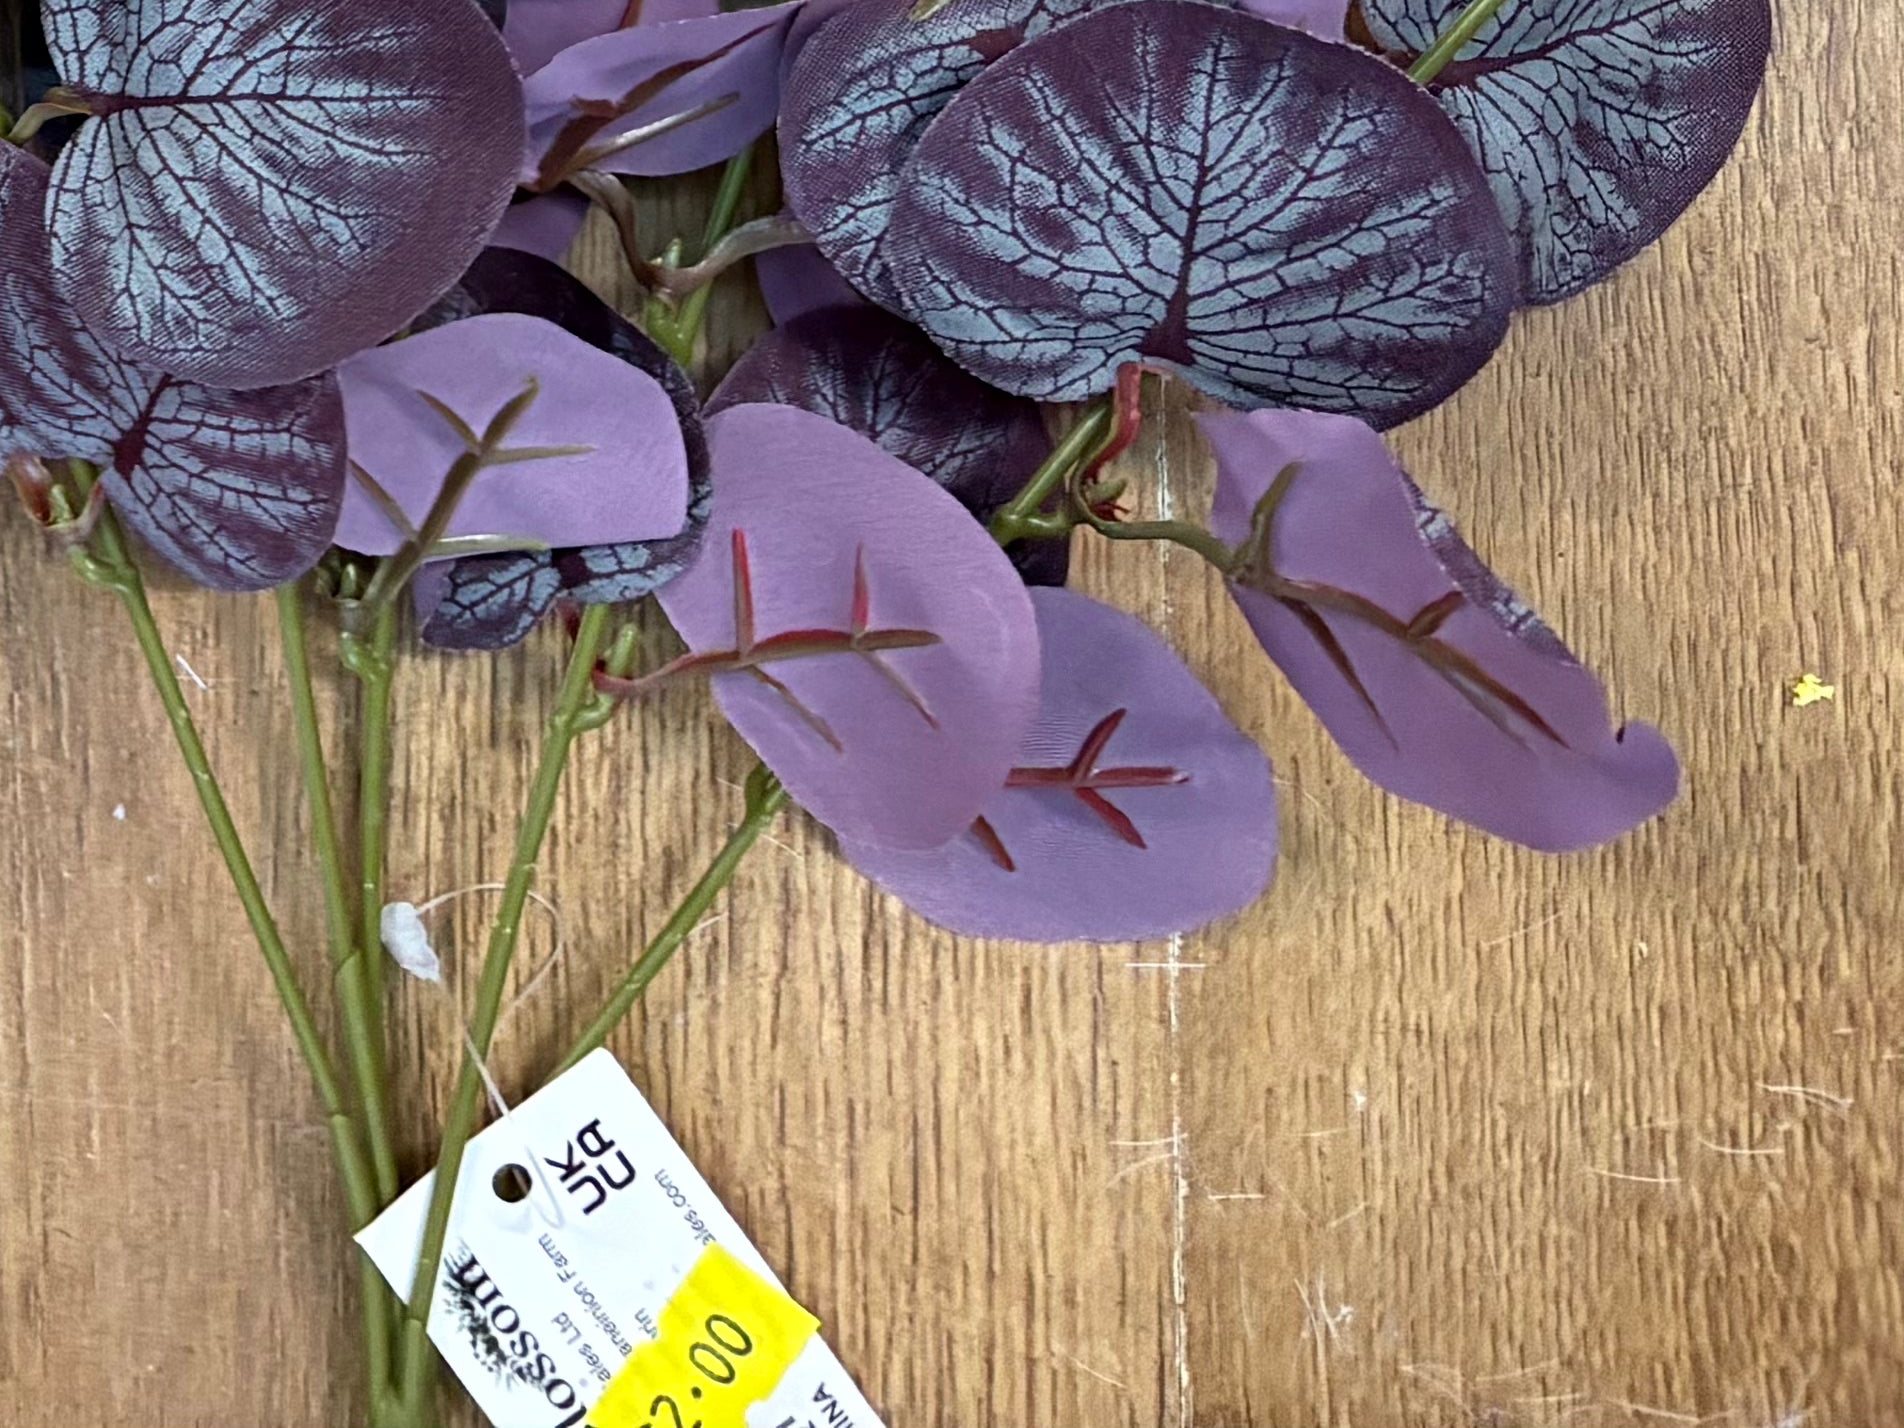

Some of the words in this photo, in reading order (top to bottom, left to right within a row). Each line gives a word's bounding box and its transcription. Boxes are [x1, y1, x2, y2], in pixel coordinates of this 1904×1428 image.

[654, 1169, 716, 1246] ales.com
[538, 1233, 576, 1283] Farm
[456, 1251, 594, 1428] lossom
[551, 1311, 582, 1345] Ltd
[578, 1343, 611, 1389] ales
[641, 1314, 753, 1428] 2.00
